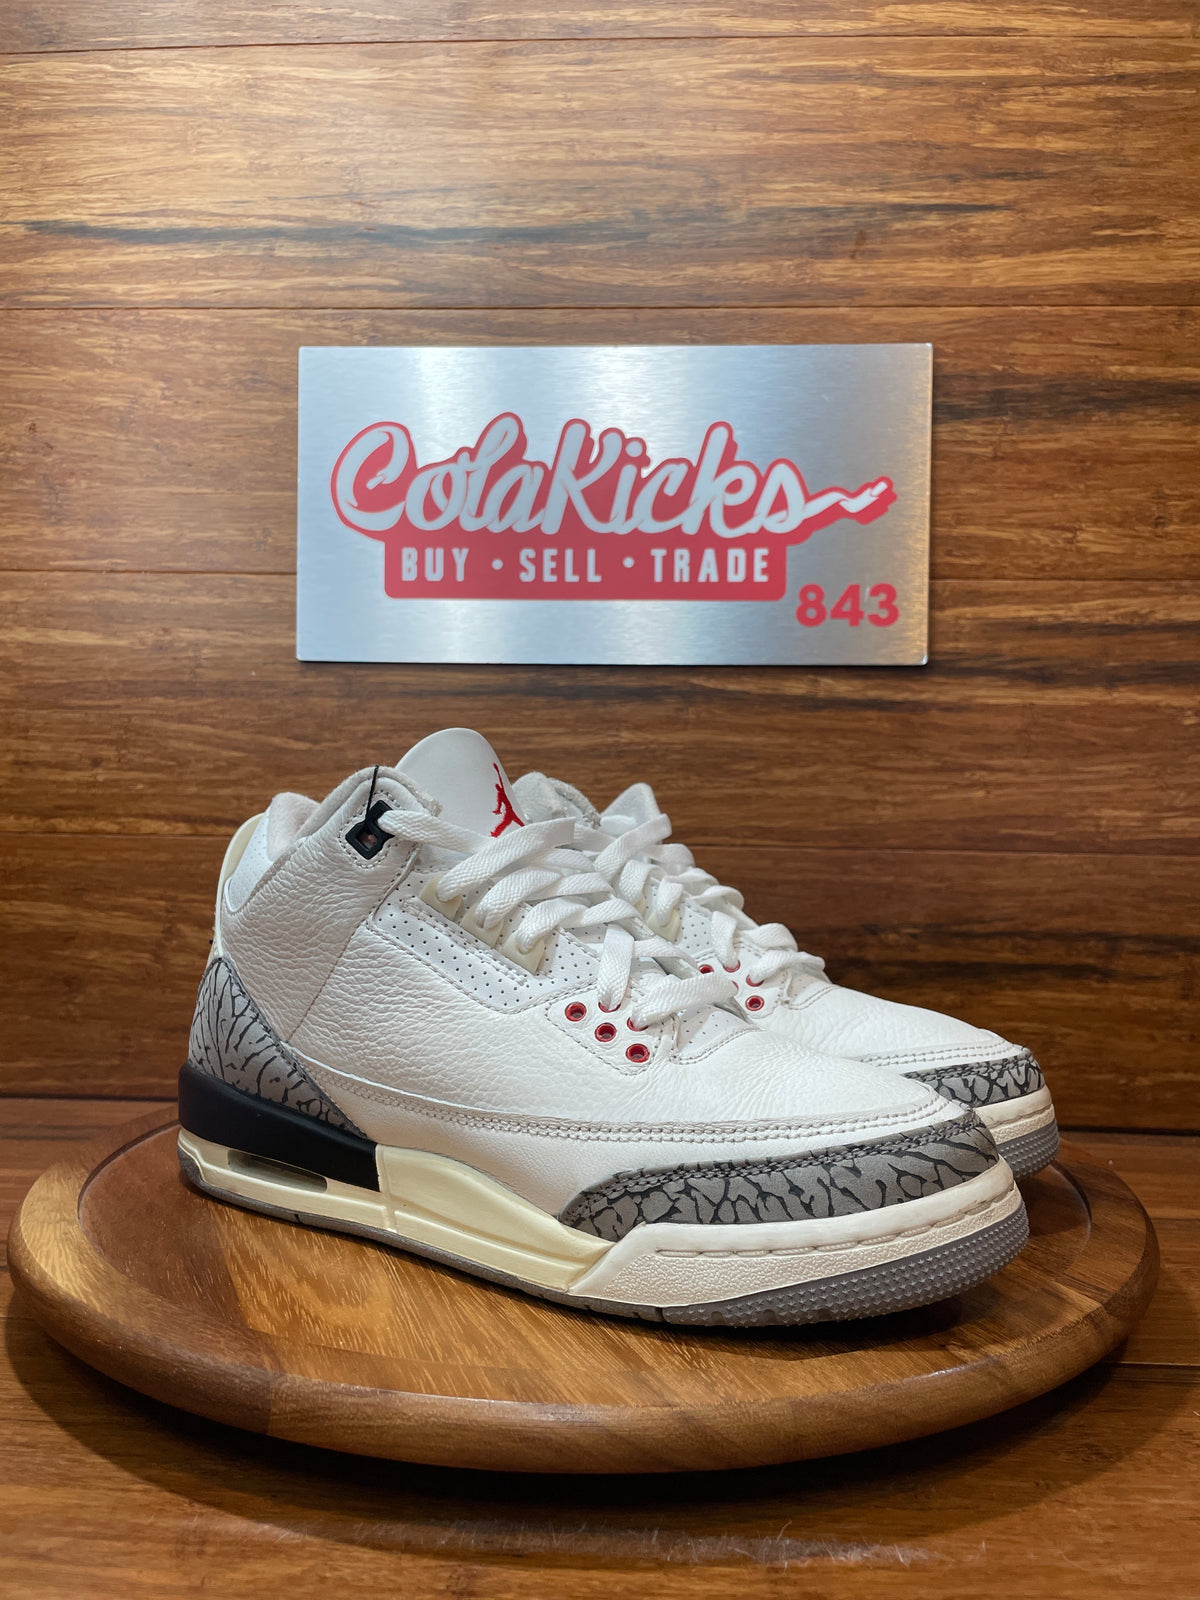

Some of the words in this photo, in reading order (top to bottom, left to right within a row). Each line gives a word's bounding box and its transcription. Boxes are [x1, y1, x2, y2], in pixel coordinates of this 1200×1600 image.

[401, 547, 469, 583] BUY
[519, 547, 602, 584] SELL
[651, 547, 770, 583] TRADE
[795, 583, 899, 628] 843
